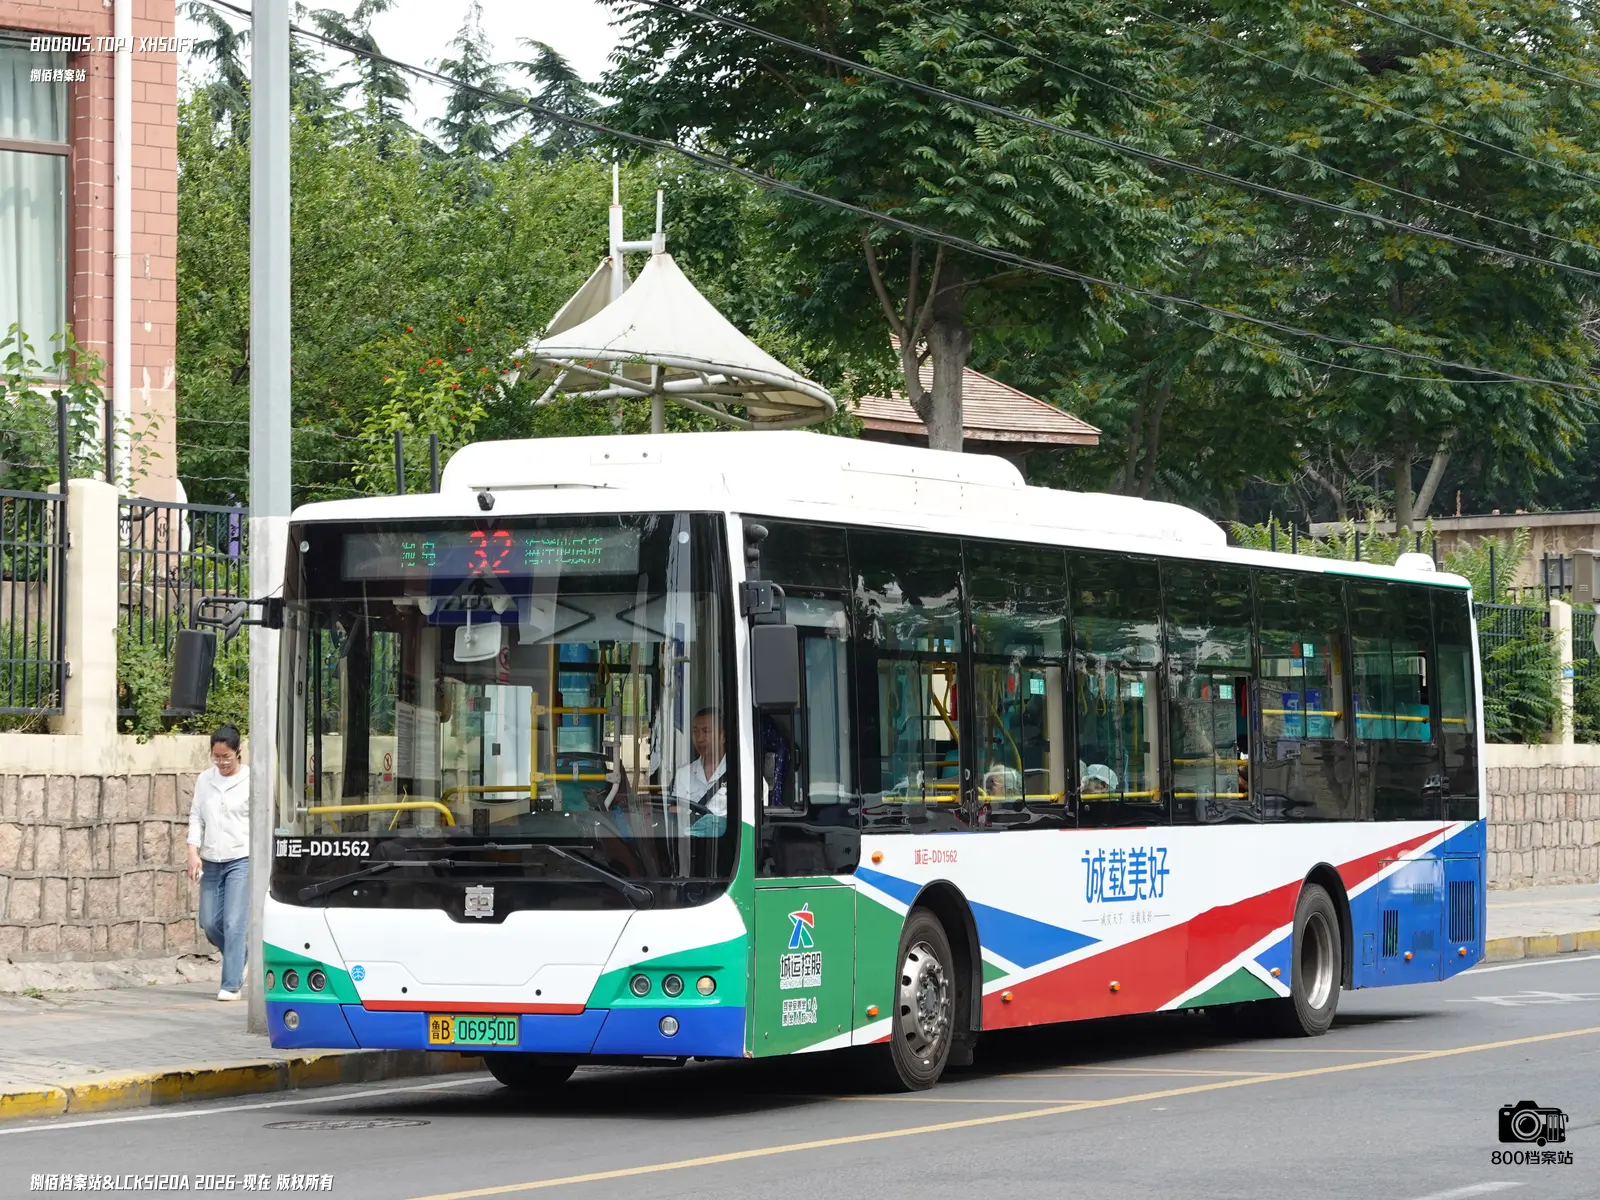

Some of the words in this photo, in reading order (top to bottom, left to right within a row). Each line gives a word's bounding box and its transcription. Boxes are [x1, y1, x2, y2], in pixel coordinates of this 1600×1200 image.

[469, 530, 511, 574] 32
[276, 839, 370, 858] 城运-DD1562
[1081, 846, 1170, 904] 诚载美好
[780, 952, 821, 979] 城运控股
[432, 1020, 450, 1040] 鲁B
[458, 1020, 516, 1041] 06950D
